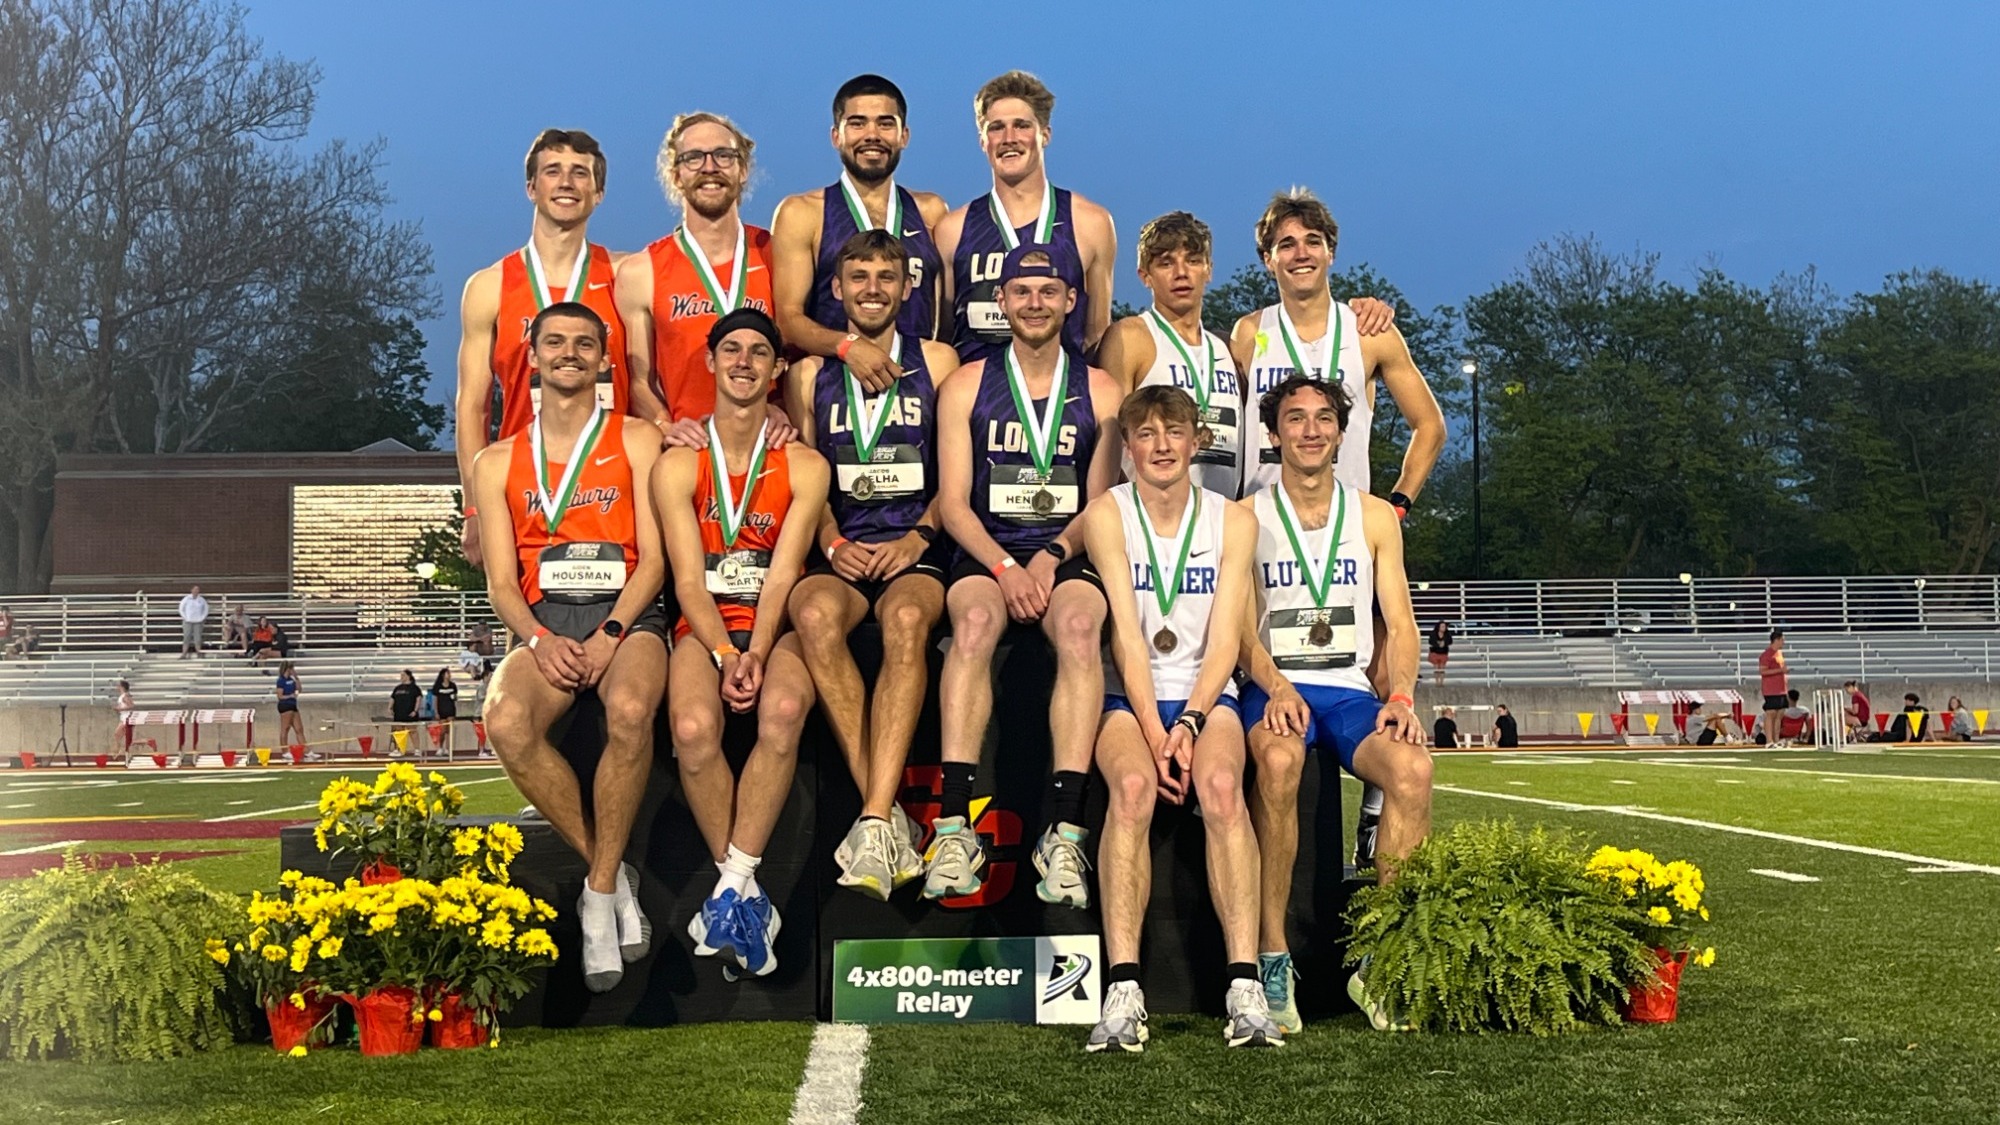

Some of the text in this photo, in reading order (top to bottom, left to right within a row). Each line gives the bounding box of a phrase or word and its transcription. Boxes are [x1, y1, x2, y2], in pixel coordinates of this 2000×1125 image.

[985, 312, 1008, 321] FRA
[1169, 364, 1239, 396] LUER
[987, 419, 1078, 456] LOS
[868, 474, 900, 483] ELHA
[552, 571, 612, 581] HOUSMAN
[1134, 563, 1215, 594] LUER
[847, 965, 1023, 988] 4x800-meter
[896, 991, 973, 1019] Relay
